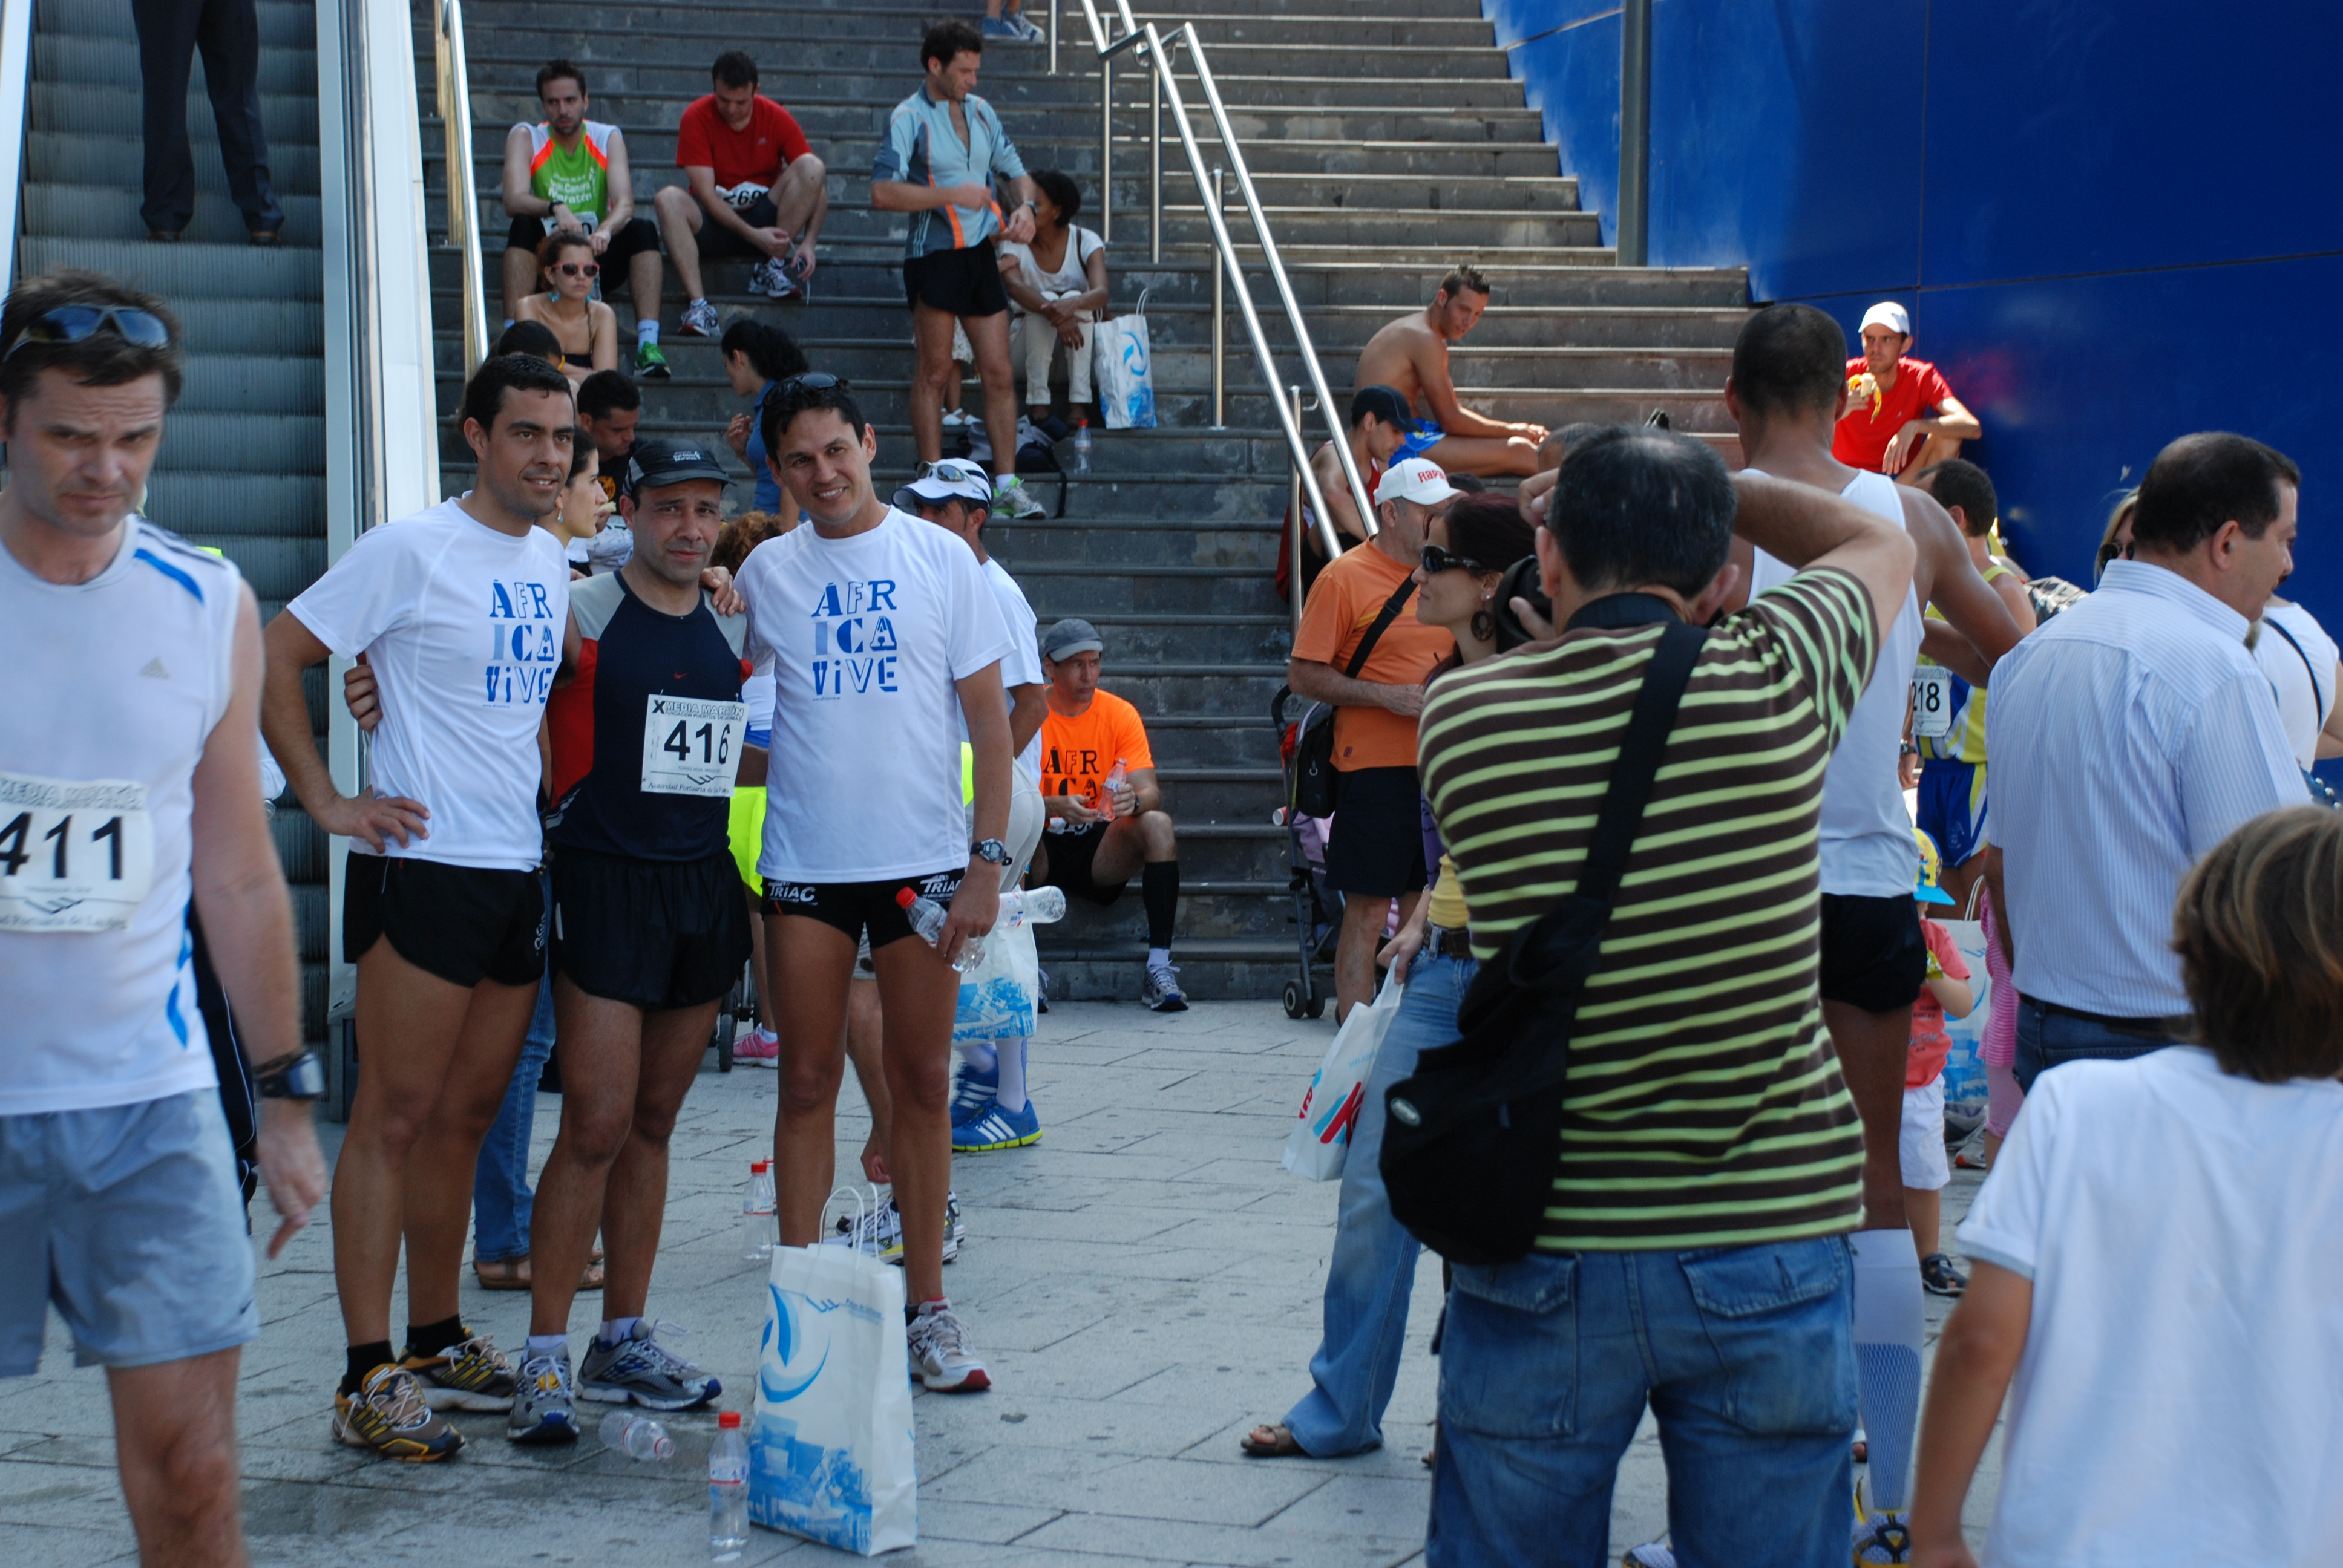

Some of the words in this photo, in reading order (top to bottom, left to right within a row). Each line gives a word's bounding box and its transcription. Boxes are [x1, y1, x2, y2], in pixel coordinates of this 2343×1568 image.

[652, 699, 666, 714] X
[666, 701, 699, 713] MEDIA
[663, 720, 730, 765] 416
[648, 782, 678, 791] Autoridad
[678, 784, 706, 793] Portuaria
[0, 811, 124, 880] 411
[767, 881, 816, 903] TRIAC
